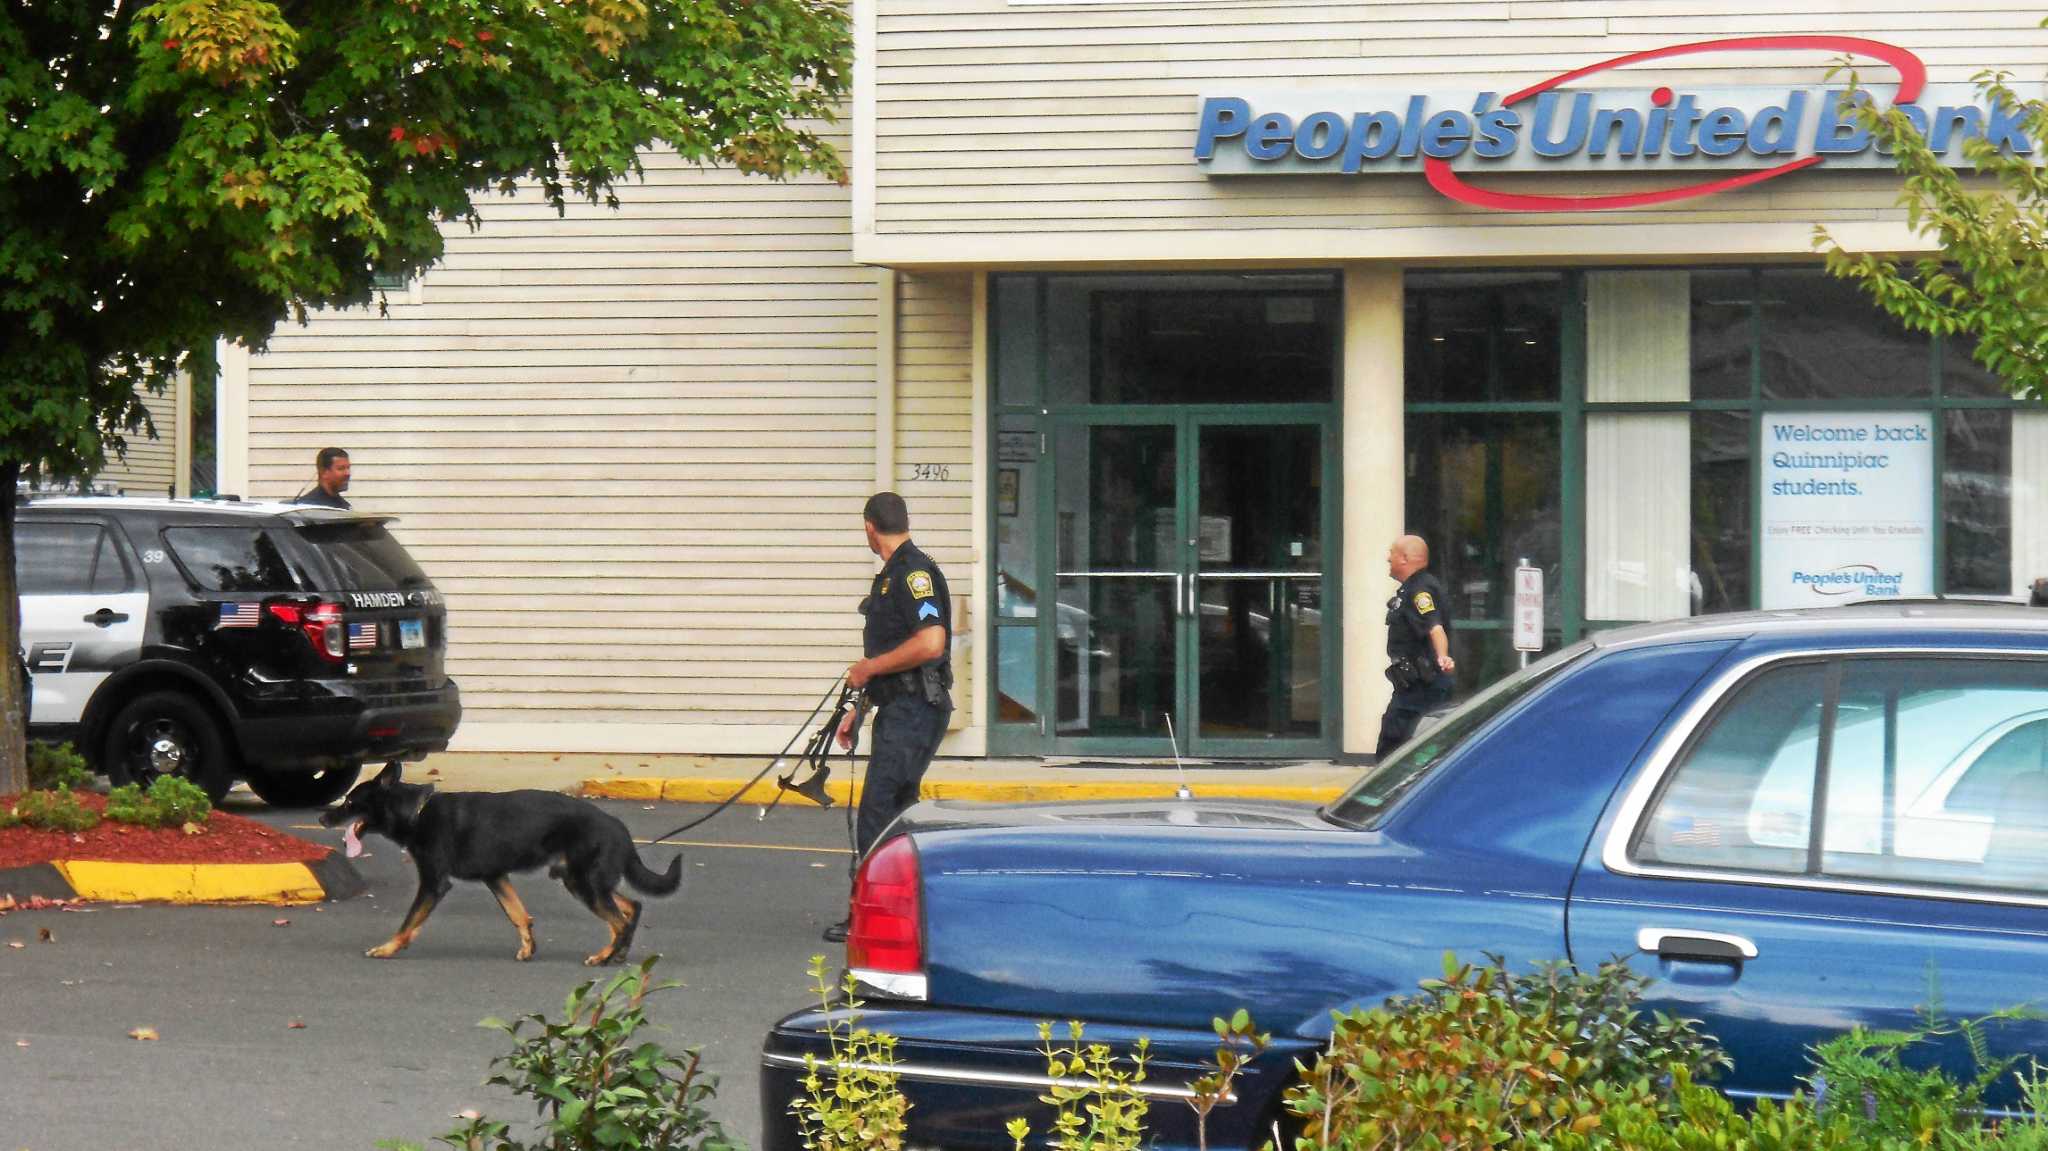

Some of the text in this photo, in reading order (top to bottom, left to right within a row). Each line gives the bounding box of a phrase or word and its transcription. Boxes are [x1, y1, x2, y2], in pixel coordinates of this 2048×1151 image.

[1194, 91, 1522, 174] People's
[1531, 87, 1810, 157] United
[1772, 424, 1928, 442] Welcome back
[1772, 451, 1889, 472] Quinnipiac
[911, 463, 951, 481] 3496
[1772, 478, 1863, 496] students.
[1791, 526, 1811, 535] FREE
[143, 550, 164, 563] 39
[1792, 571, 1904, 587] People's United
[1865, 584, 1901, 597] Bank
[351, 592, 405, 608] HAMDEN
